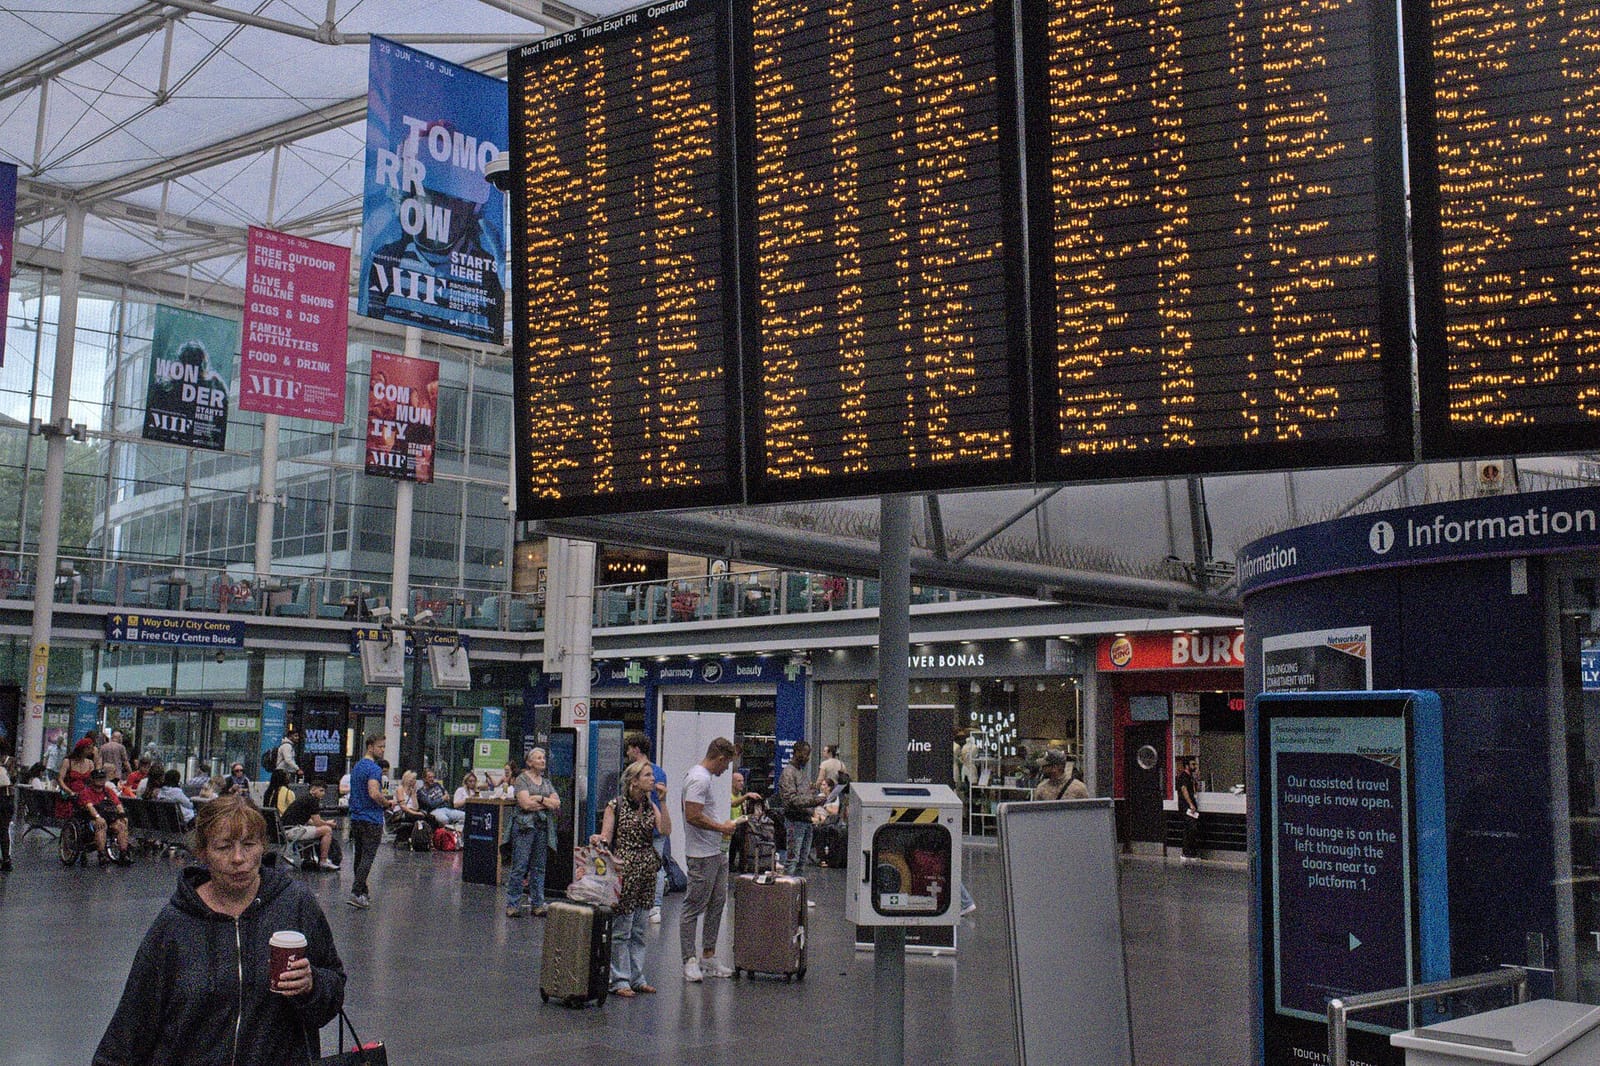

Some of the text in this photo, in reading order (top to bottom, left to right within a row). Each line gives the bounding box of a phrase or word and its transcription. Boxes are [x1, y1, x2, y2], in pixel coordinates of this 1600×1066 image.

[520, 44, 539, 57] Next
[541, 36, 562, 51] Train
[563, 31, 577, 44] To:
[581, 25, 602, 38] Time
[603, 17, 624, 33] Expt
[647, 0, 688, 18] Operator
[395, 49, 411, 62] JUN
[439, 65, 454, 77] JUL
[403, 114, 500, 175] TOMO
[374, 147, 427, 197] RR
[400, 198, 451, 243] OW
[254, 256, 295, 273] EVENTS
[255, 245, 336, 271] FREE OUTDOOR
[450, 251, 497, 273] STARTS
[253, 273, 295, 291] LIVE &
[450, 264, 482, 283] HERE
[252, 284, 334, 309] ONLINE SHOWS
[251, 302, 320, 325] GIGS & DJS
[250, 321, 292, 337] FAMILY
[249, 332, 319, 352] ACTIVITIES
[156, 358, 199, 384] WON
[248, 350, 331, 372] FOOD & DRINK
[181, 384, 224, 409] DER
[373, 382, 410, 404] COM
[396, 404, 431, 426] MUN
[371, 419, 408, 440] ITY
[1408, 505, 1596, 547] Information
[1237, 545, 1297, 580] Information
[143, 617, 161, 628] Way
[163, 619, 179, 628] Out
[186, 620, 202, 630] City
[204, 621, 231, 631] Centre
[141, 631, 236, 644] Free City Centre Buses
[939, 653, 984, 667] BONAS
[660, 668, 693, 680] pharmacy
[736, 665, 762, 677] beauty
[306, 729, 340, 739] WIN A
[1288, 775, 1389, 791] Our assisted travel
[1284, 791, 1394, 810] lounge is now open.
[1283, 822, 1397, 843] The lounge is on the
[1295, 839, 1384, 859] left through the
[1302, 856, 1377, 875] doors near to
[1308, 874, 1357, 890] platform
[1292, 1047, 1320, 1061] TOUCH
